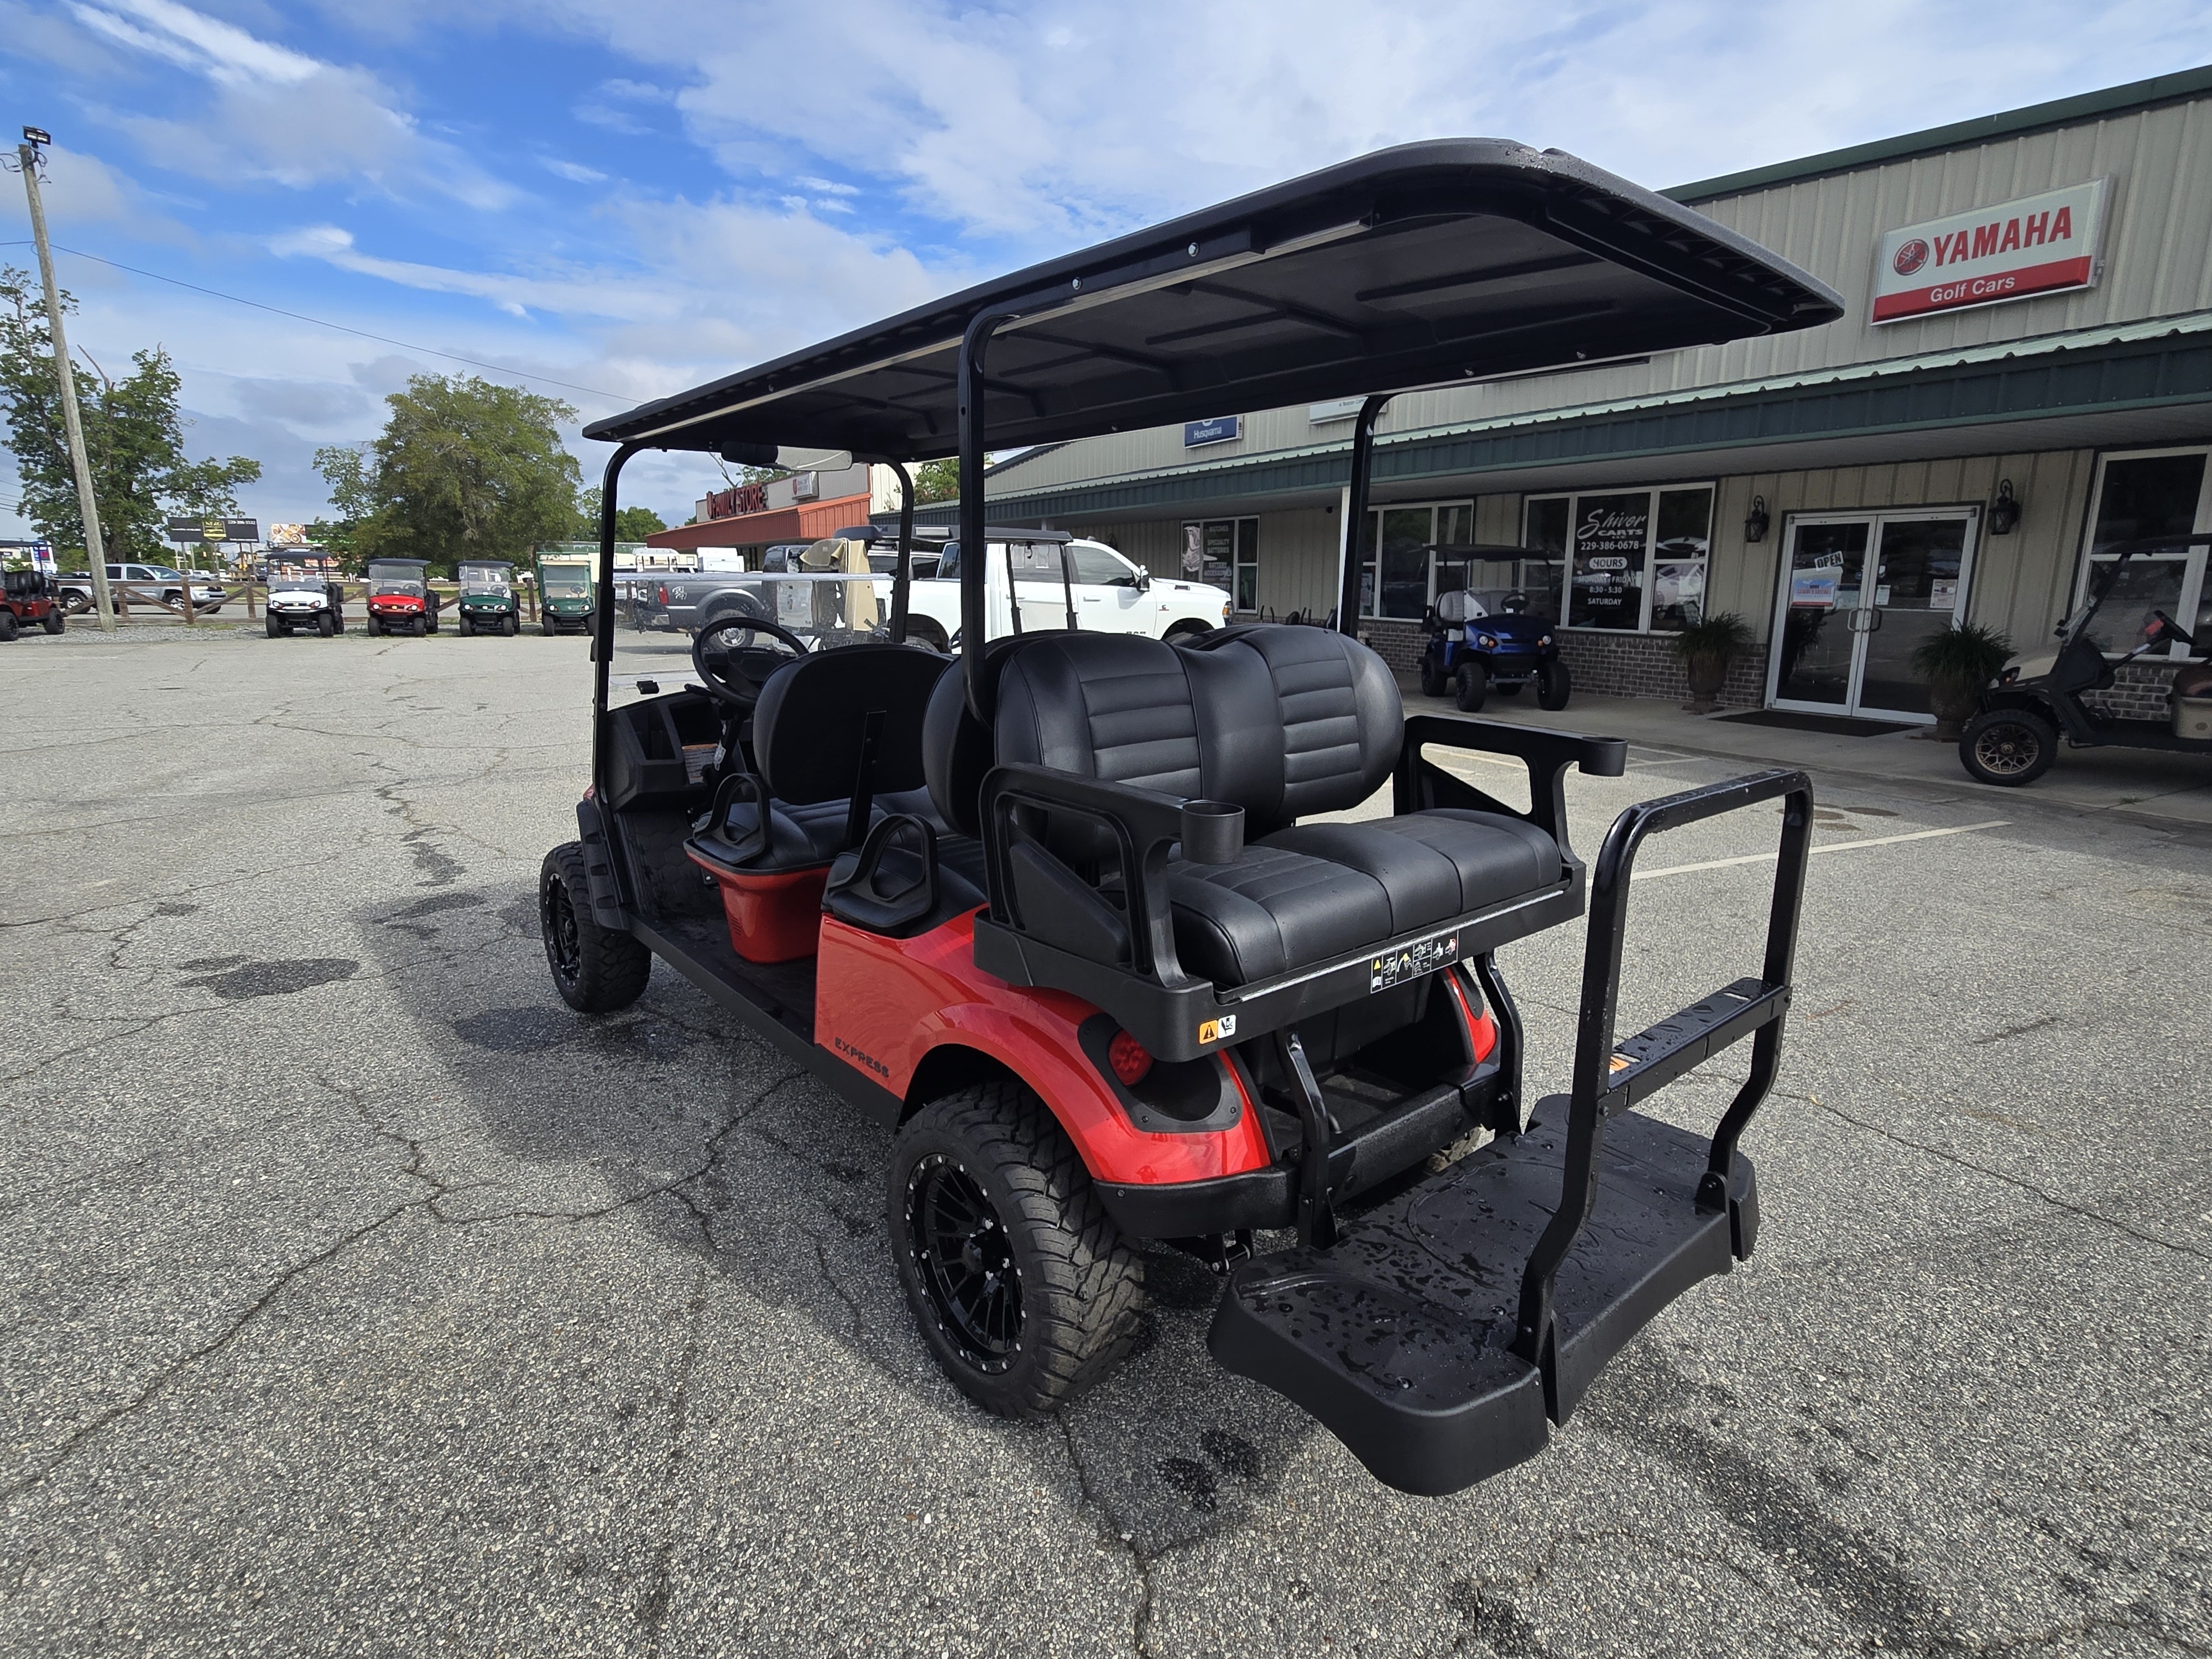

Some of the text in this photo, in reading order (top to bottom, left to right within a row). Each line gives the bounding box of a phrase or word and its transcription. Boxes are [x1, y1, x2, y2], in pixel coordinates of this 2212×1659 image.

[1933, 206, 2072, 267] YAMAHA
[1930, 276, 2015, 303] Golf Cars
[1194, 426, 1222, 439] Husqvarna
[712, 489, 734, 518] FAMILY
[737, 483, 763, 512] STORE
[1577, 509, 1646, 539] Shiver
[1581, 541, 1639, 550] 229-386-0678
[1593, 559, 1623, 567] HOURS
[1817, 553, 1841, 568] OPEN
[835, 1036, 889, 1078] EXPRESS
